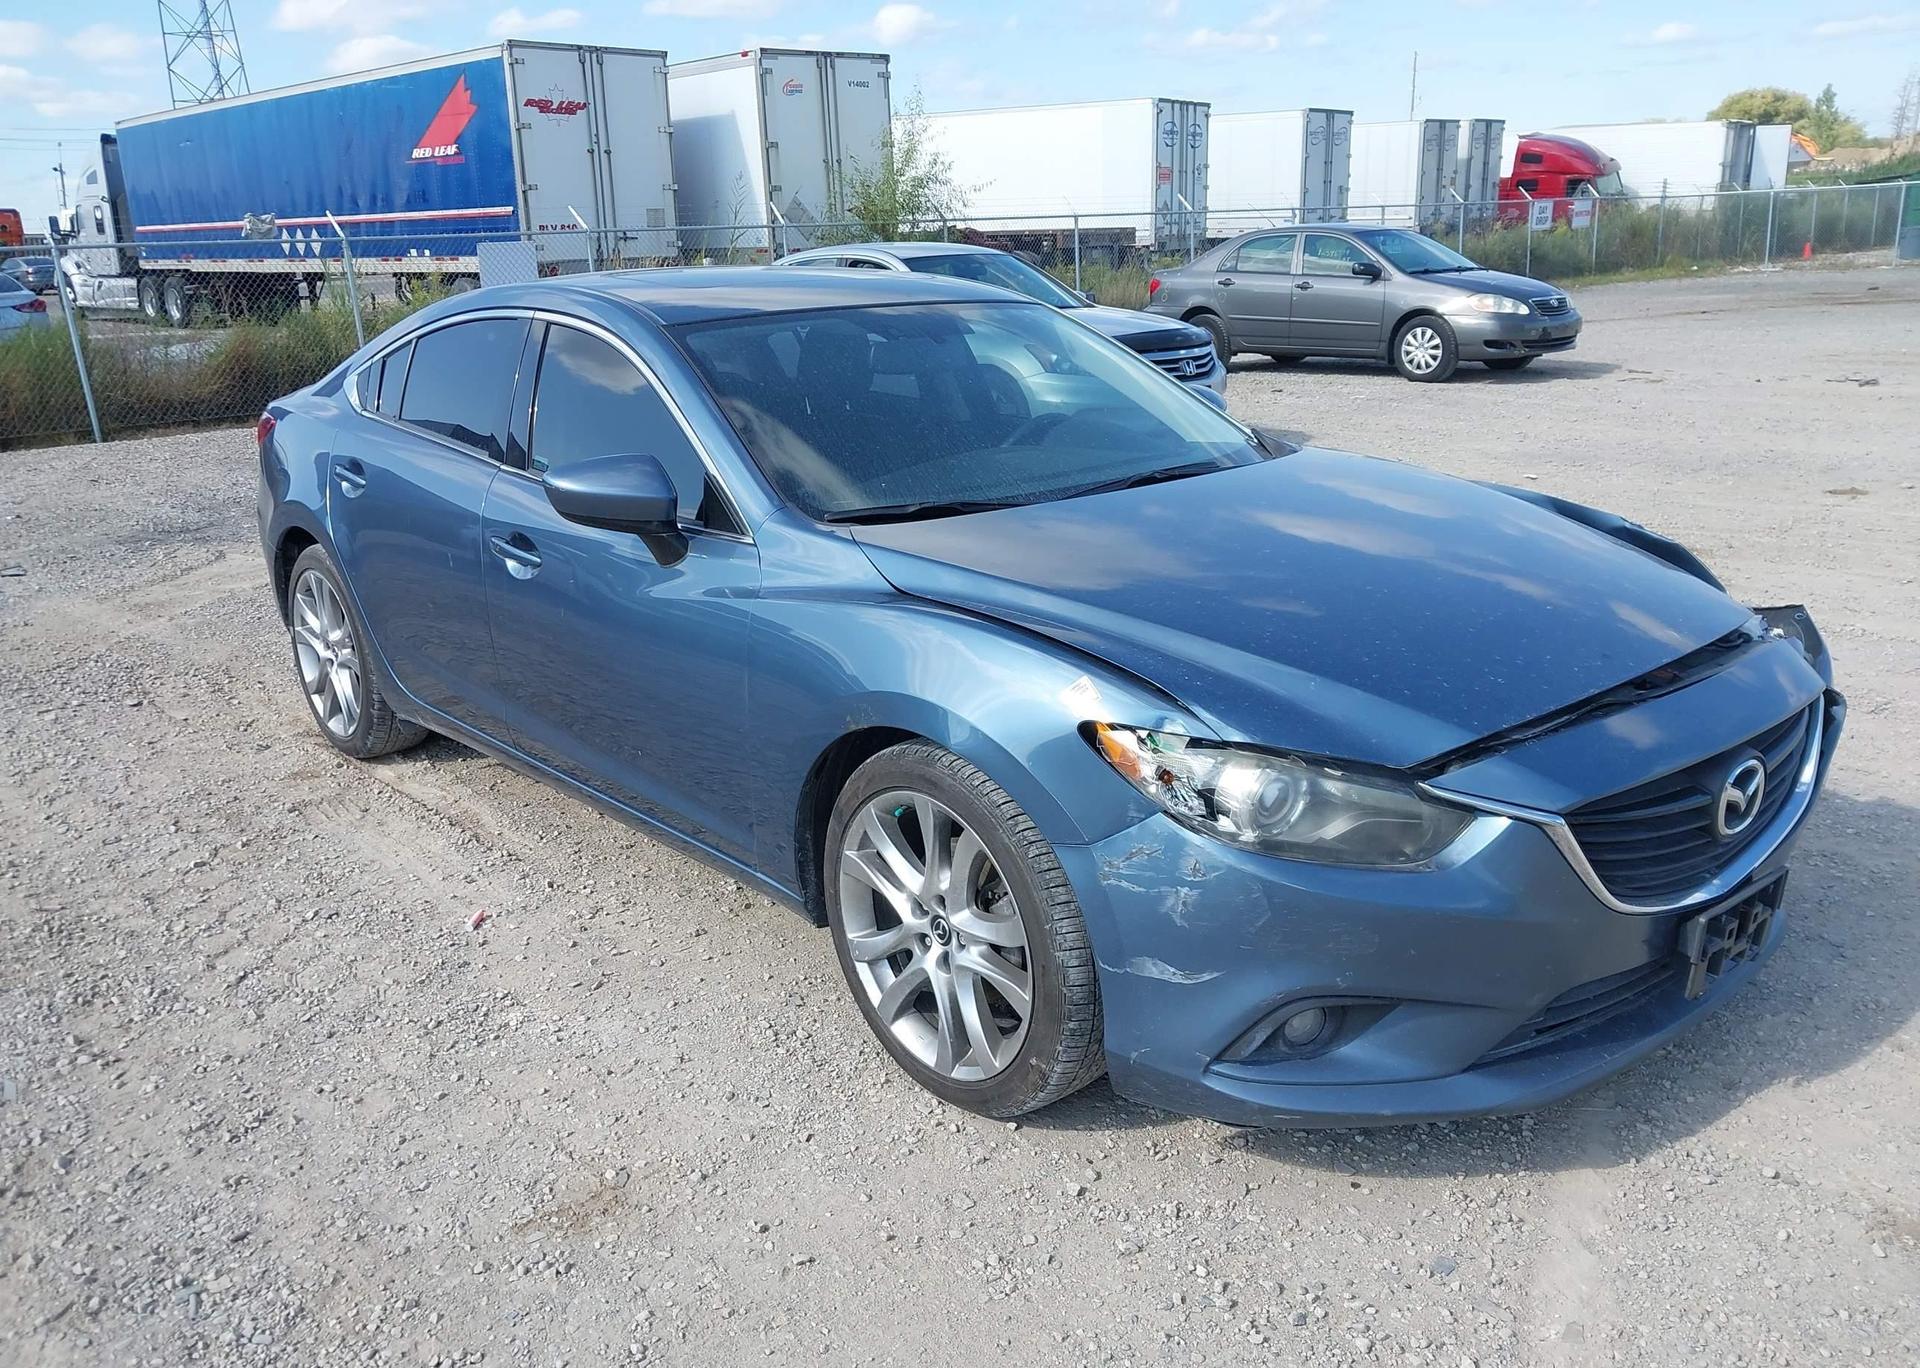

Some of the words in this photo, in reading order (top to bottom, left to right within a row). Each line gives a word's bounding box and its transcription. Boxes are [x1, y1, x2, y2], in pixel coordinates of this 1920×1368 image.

[847, 79, 870, 88] V14002
[523, 98, 554, 108] RED
[411, 147, 433, 159] RED
[433, 144, 460, 157] LEAF
[1538, 205, 1548, 215] DAY
[1535, 216, 1549, 226] DROP
